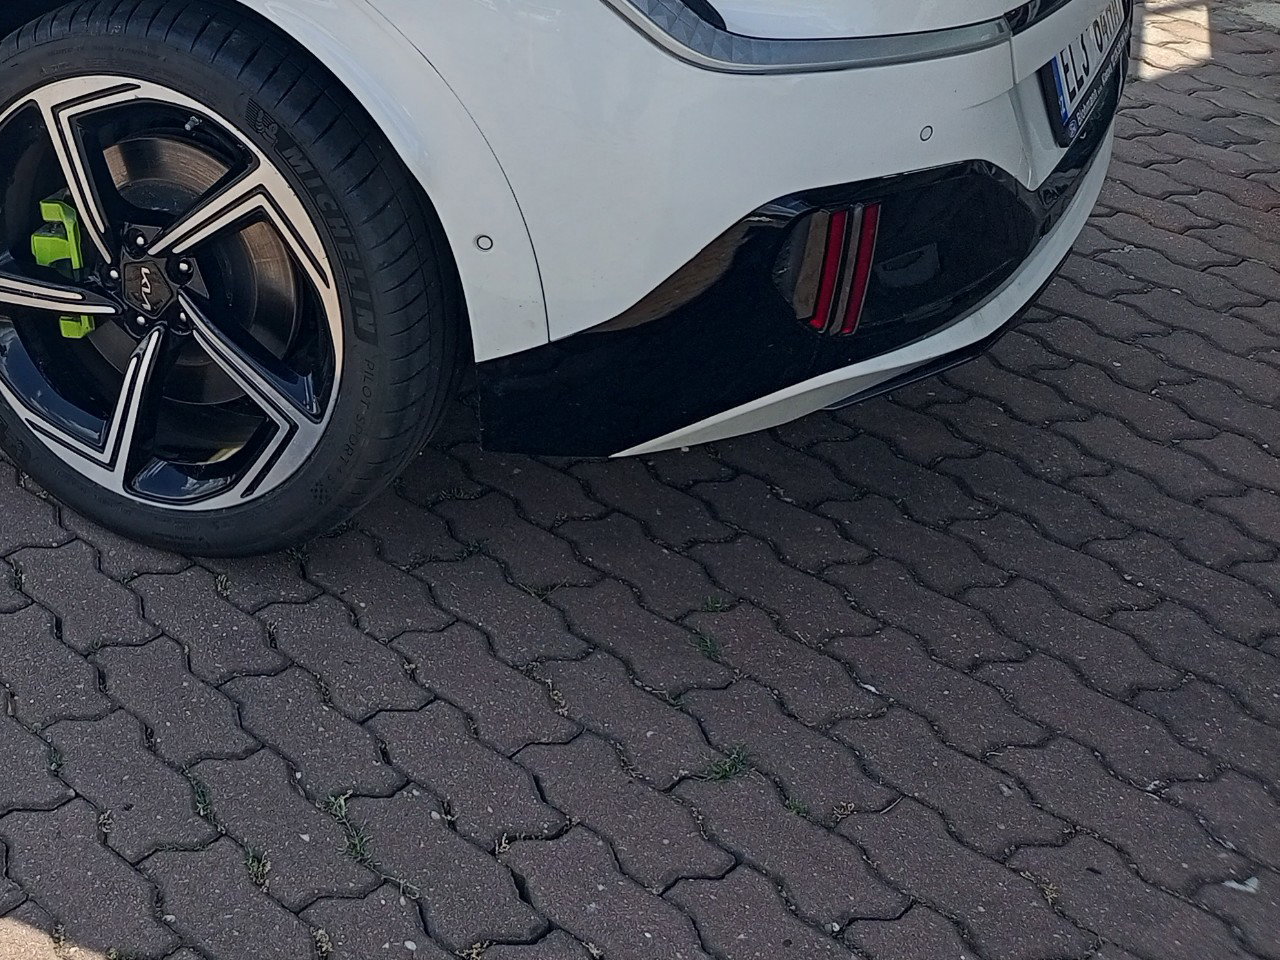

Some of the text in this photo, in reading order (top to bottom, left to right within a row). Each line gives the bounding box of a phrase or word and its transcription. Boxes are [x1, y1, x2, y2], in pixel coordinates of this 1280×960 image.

[282, 146, 377, 337] MICHELIN
[338, 358, 376, 467] PILOT SPORT
